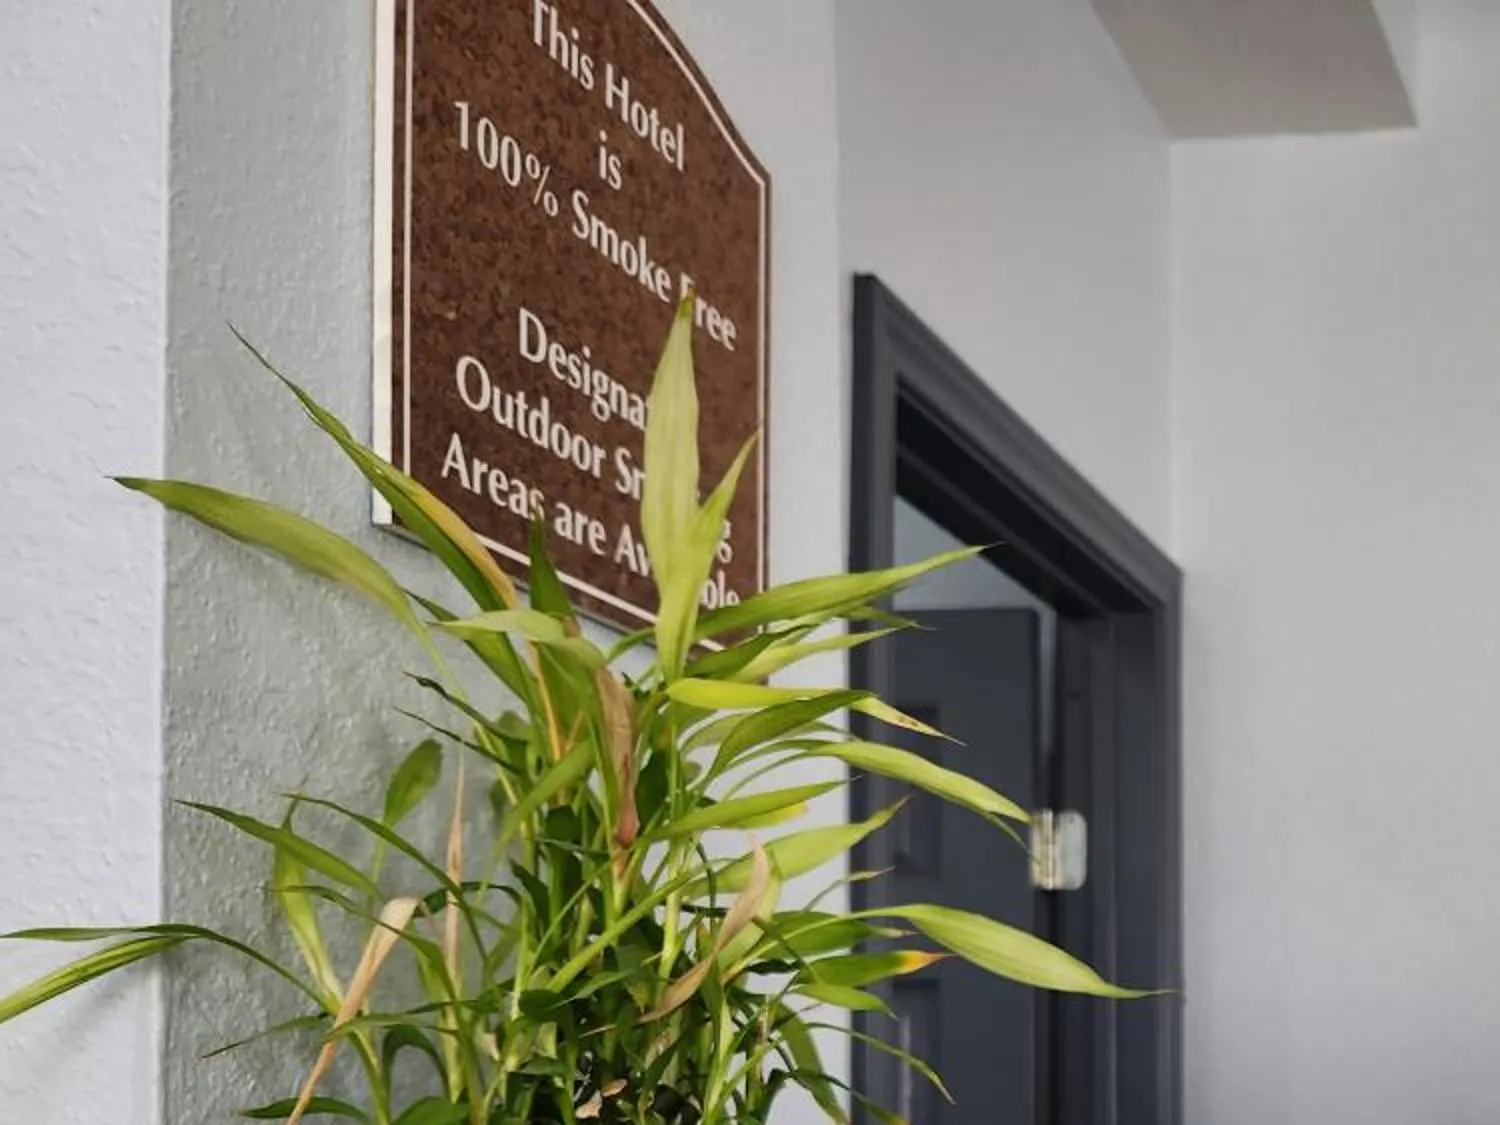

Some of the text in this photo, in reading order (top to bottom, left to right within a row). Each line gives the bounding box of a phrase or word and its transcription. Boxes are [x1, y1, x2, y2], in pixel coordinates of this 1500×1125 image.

[534, 0, 684, 172] This Hotel
[454, 101, 559, 217] 100%
[572, 188, 670, 304] Smoke
[600, 130, 622, 190] is
[456, 355, 605, 480] Outdoor
[518, 308, 646, 431] Designa
[441, 432, 544, 521] Areas
[554, 501, 605, 556] are
